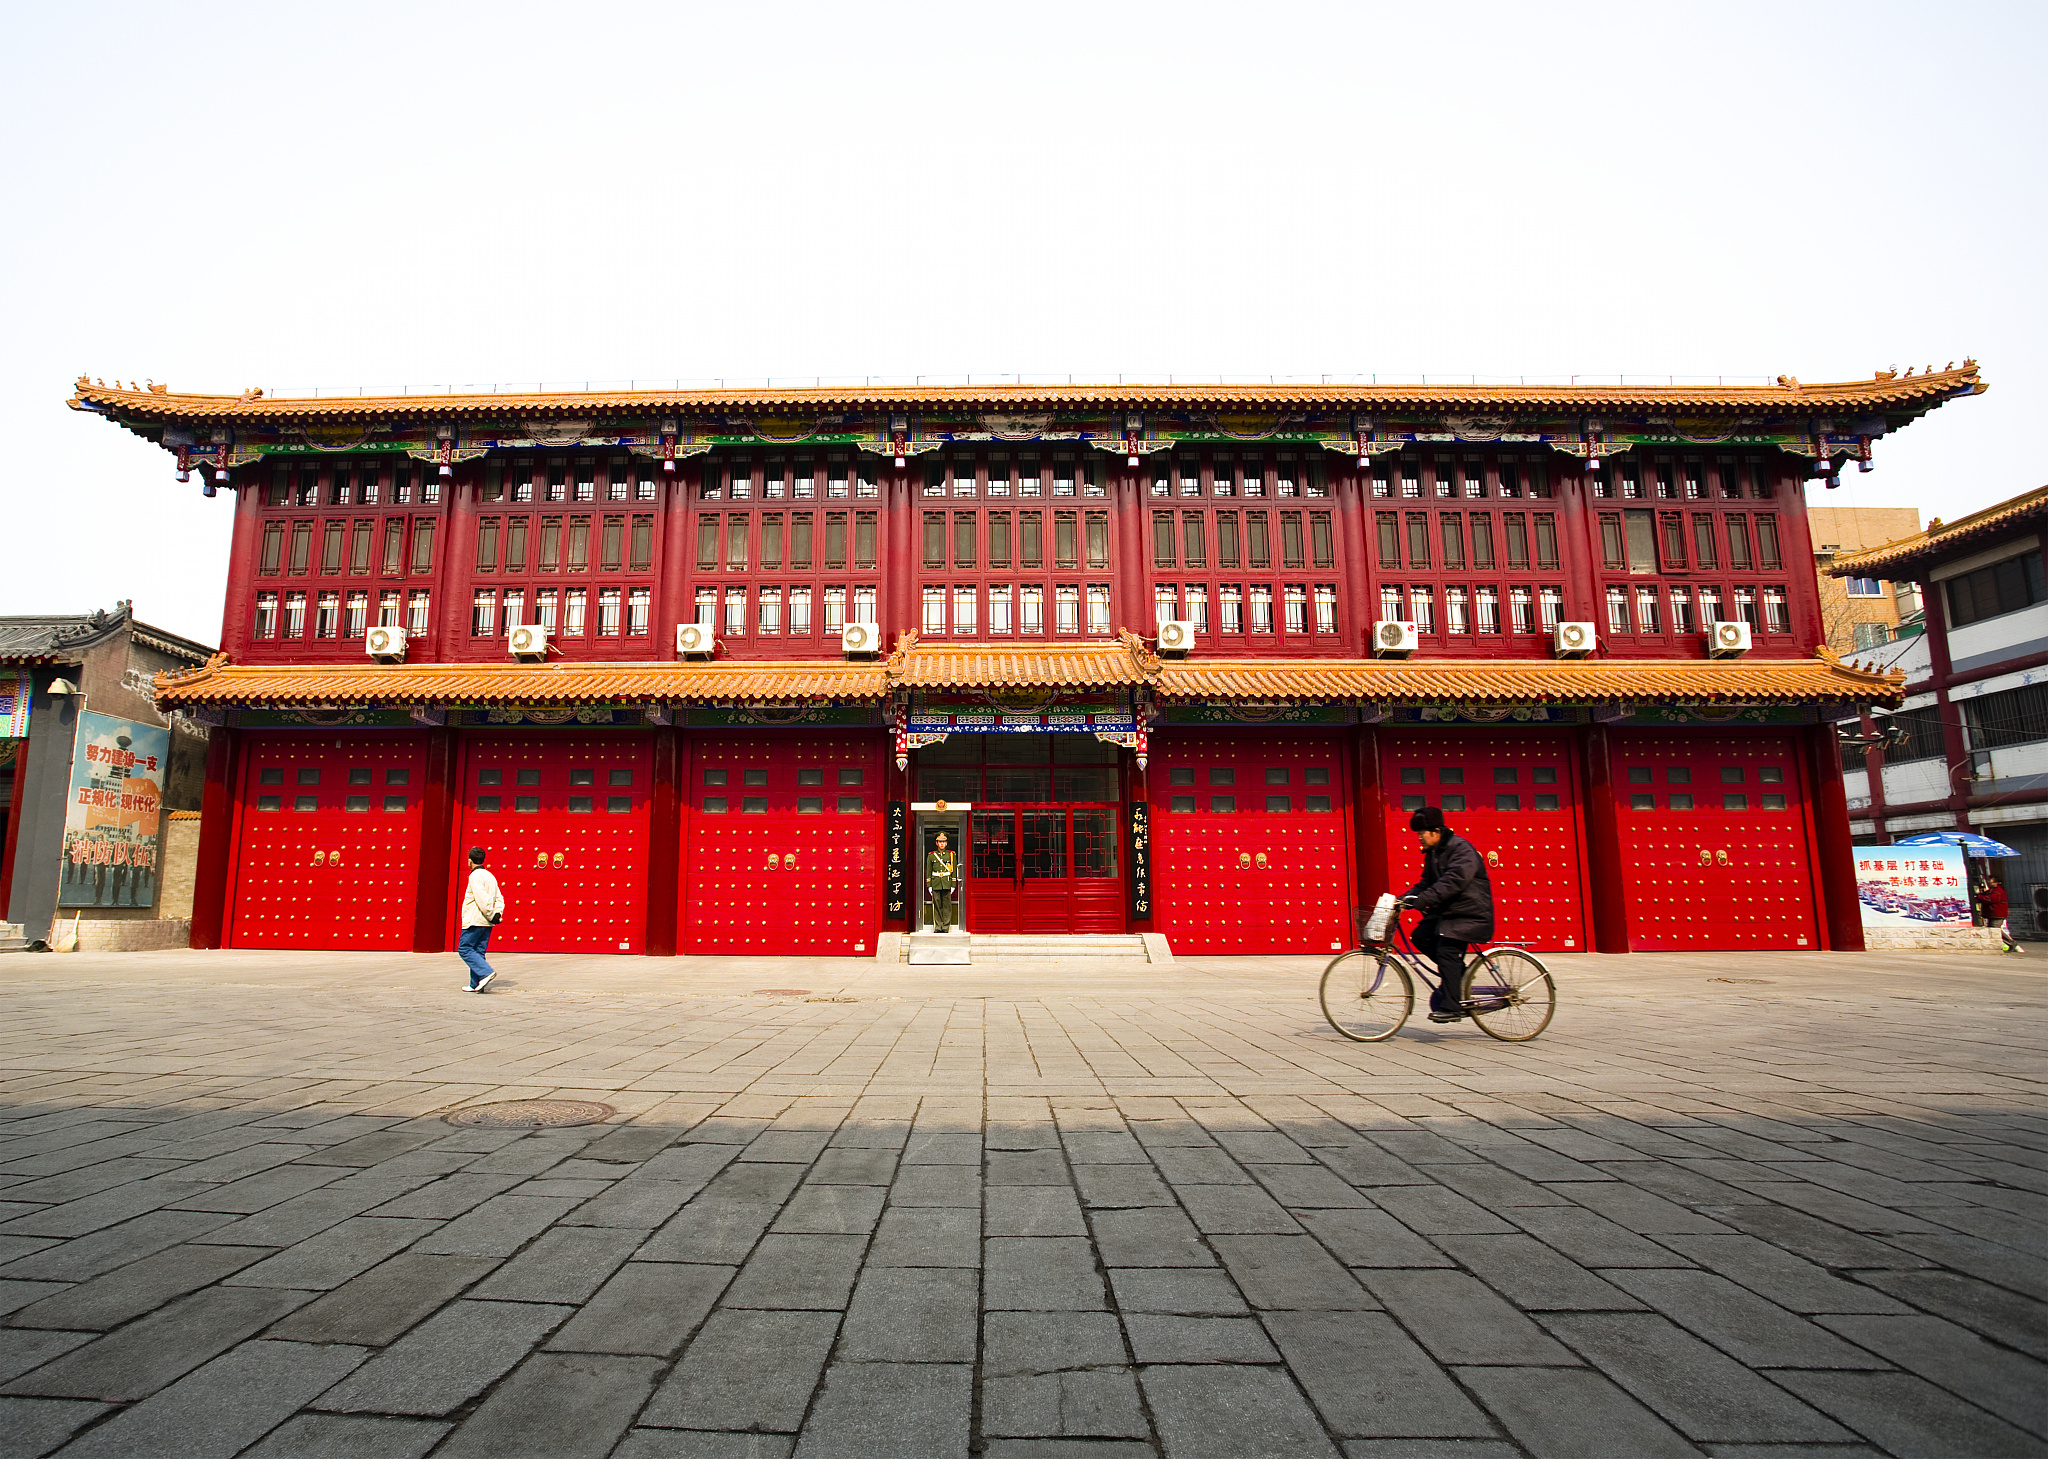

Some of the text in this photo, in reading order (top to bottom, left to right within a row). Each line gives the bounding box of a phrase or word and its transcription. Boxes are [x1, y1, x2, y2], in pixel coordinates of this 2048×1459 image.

[86, 744, 158, 772] 努力建设一支
[78, 787, 117, 809] 正规化
[120, 793, 155, 814] 现代化
[71, 839, 150, 867] 消防队伍
[1859, 860, 1945, 872] 抓基层 打基础
[1888, 876, 1958, 888] 苦练基本功
